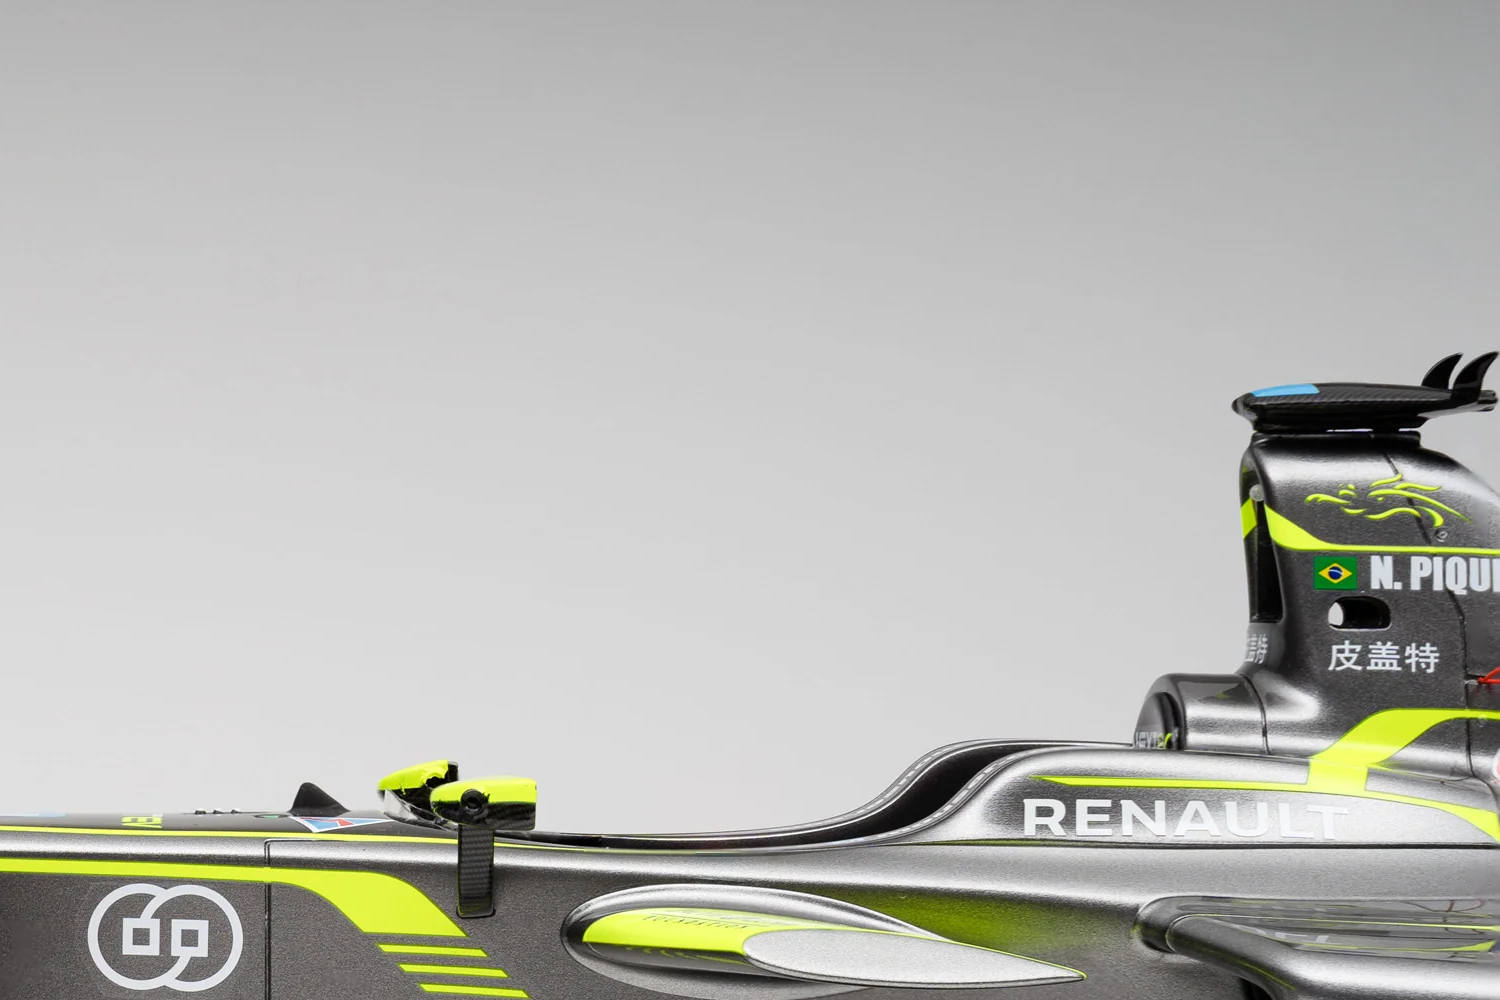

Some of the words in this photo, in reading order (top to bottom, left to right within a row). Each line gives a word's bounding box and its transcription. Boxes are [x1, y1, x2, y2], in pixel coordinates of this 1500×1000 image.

[1370, 555, 1402, 591] N.
[1327, 640, 1441, 674] 皮盖特
[1022, 797, 1349, 841] RENAULT
